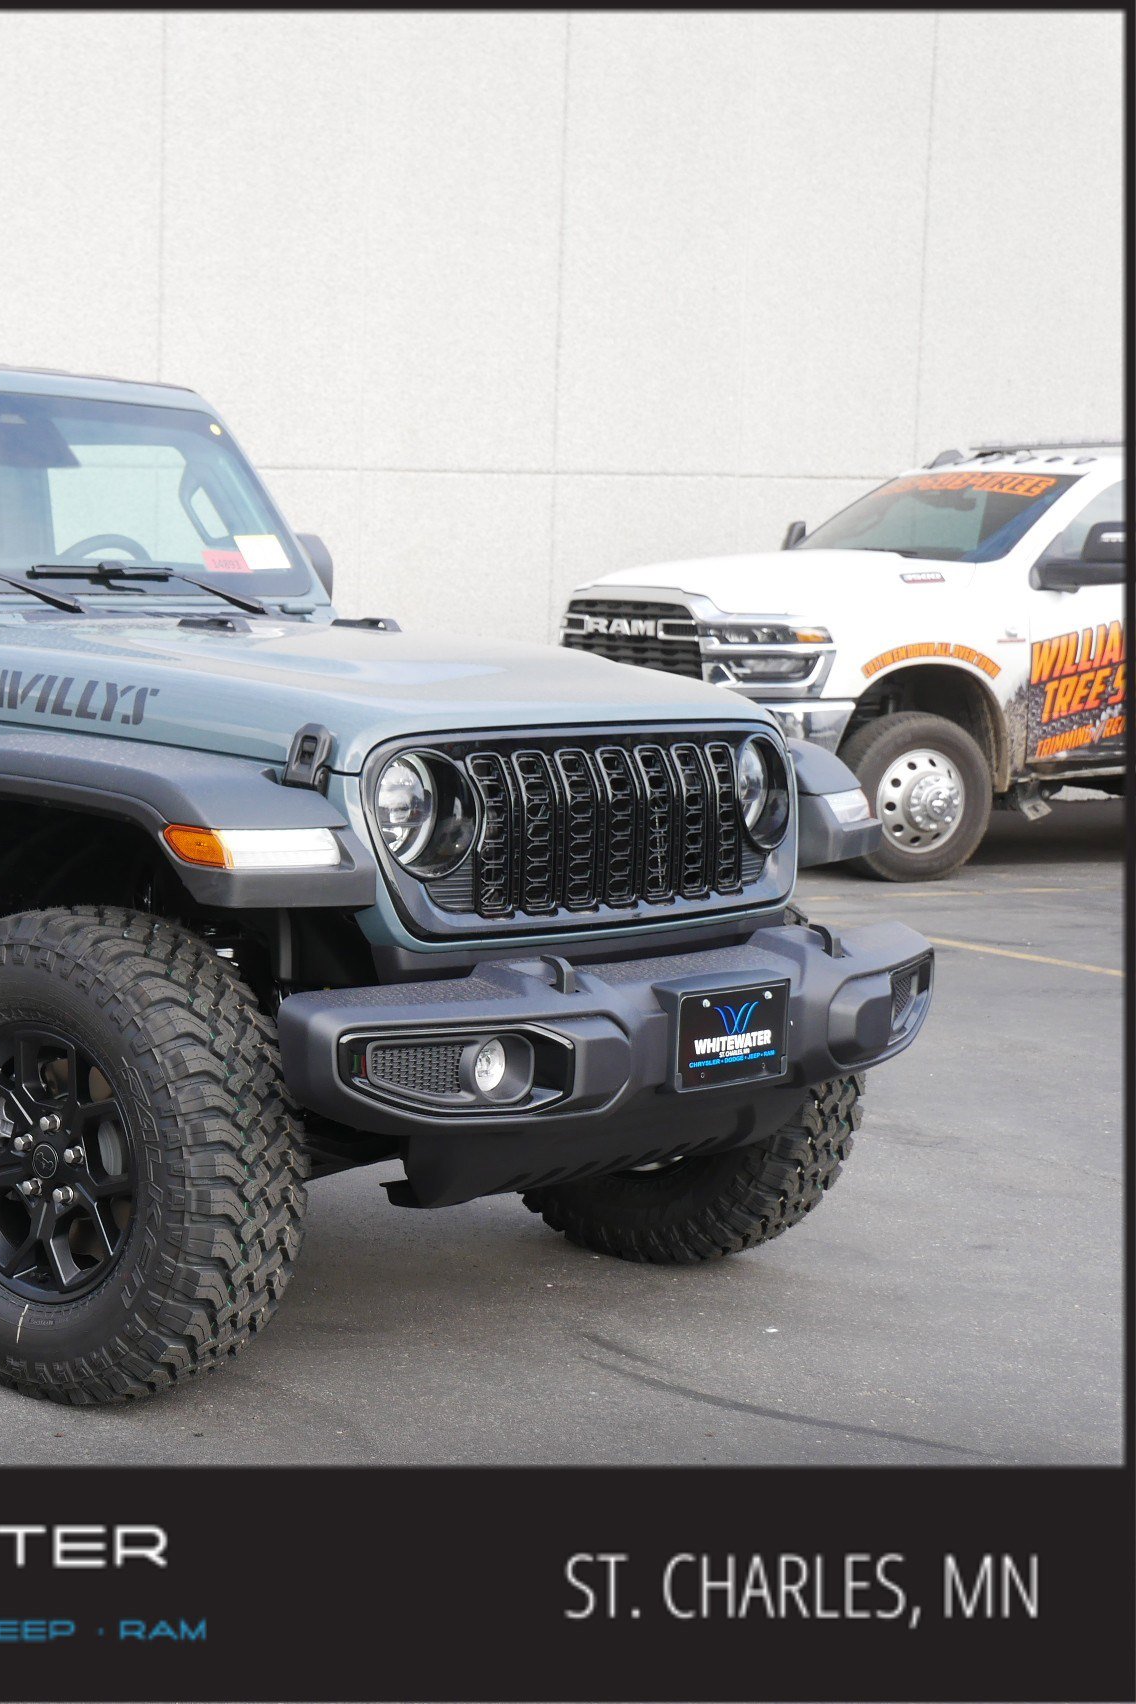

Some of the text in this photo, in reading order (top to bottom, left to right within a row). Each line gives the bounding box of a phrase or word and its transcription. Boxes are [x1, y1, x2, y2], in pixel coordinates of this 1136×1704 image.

[588, 618, 657, 636] RAM
[1030, 620, 1126, 685] WILLIA
[694, 1029, 772, 1055] WHITEWATER
[689, 1049, 776, 1068] CHRYSLER DODGE JEEP RAM
